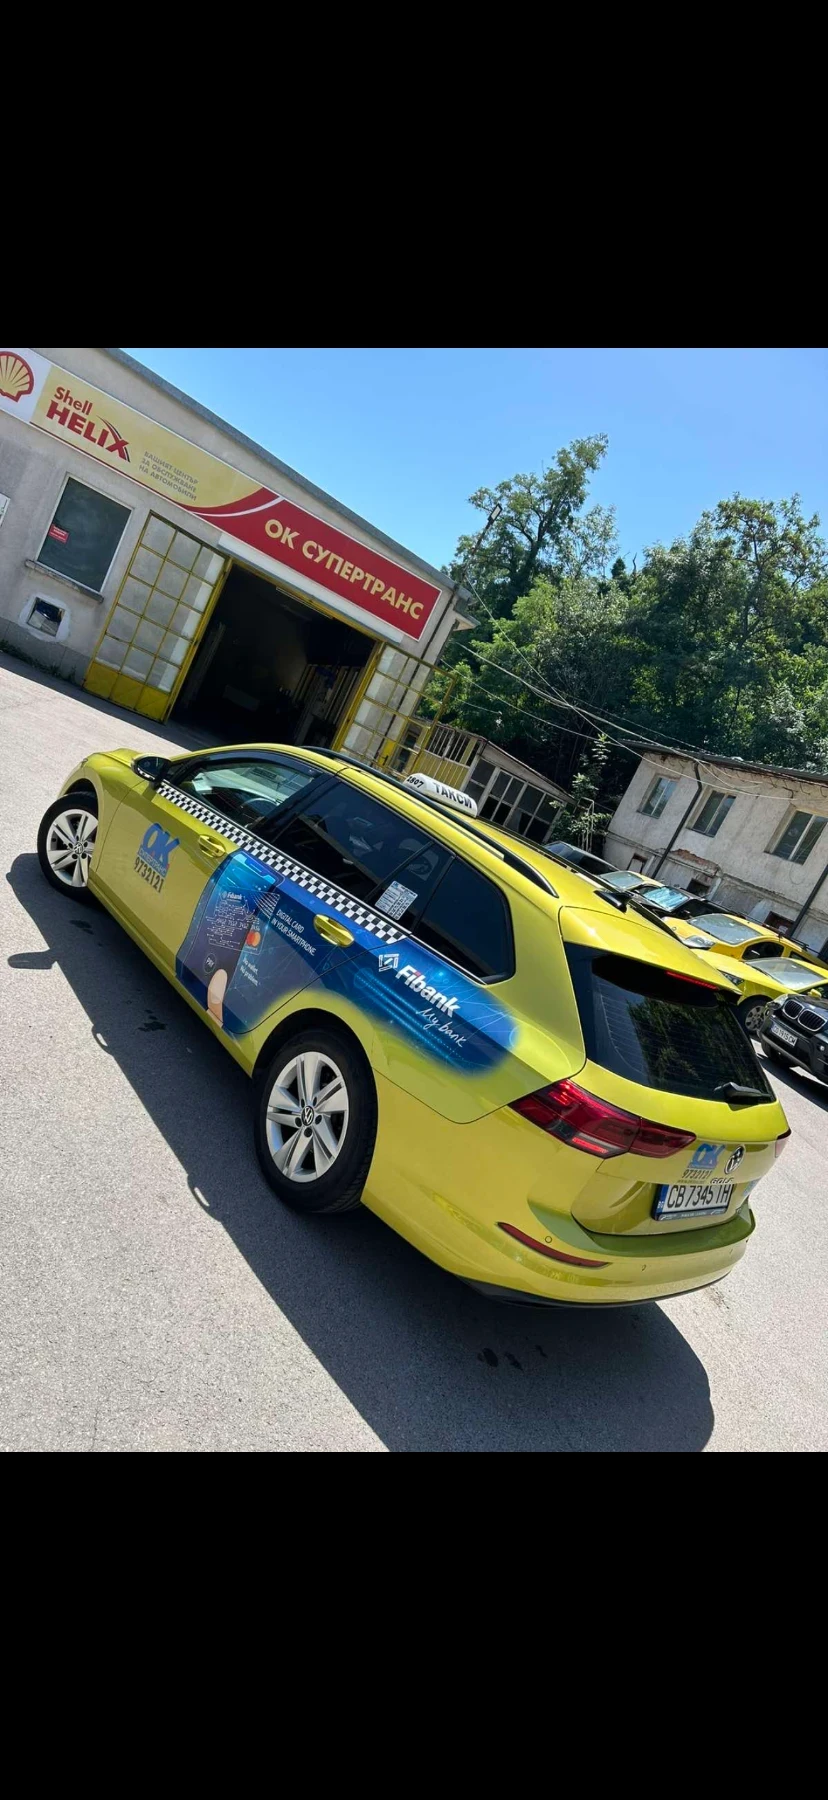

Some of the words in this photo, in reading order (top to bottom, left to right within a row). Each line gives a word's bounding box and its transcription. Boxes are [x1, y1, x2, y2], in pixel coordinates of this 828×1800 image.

[54, 386, 93, 415] Shell
[46, 400, 130, 462] HELIX
[150, 470, 197, 501] АВТОМОБИЛИ
[265, 519, 300, 549] ОК
[302, 540, 424, 620] СУПЕРТРАНС
[433, 782, 472, 809] ТАКСИ
[134, 857, 164, 893] 9732121
[276, 909, 292, 925] DIGITAL
[291, 921, 305, 933] CARD
[276, 920, 289, 934] YOUR
[395, 965, 461, 1017] Fibank
[417, 1008, 440, 1030] My
[439, 1021, 467, 1047] bank
[682, 1169, 713, 1179] 9732121
[667, 1185, 686, 1208] CB
[685, 1185, 714, 1207] 7345
